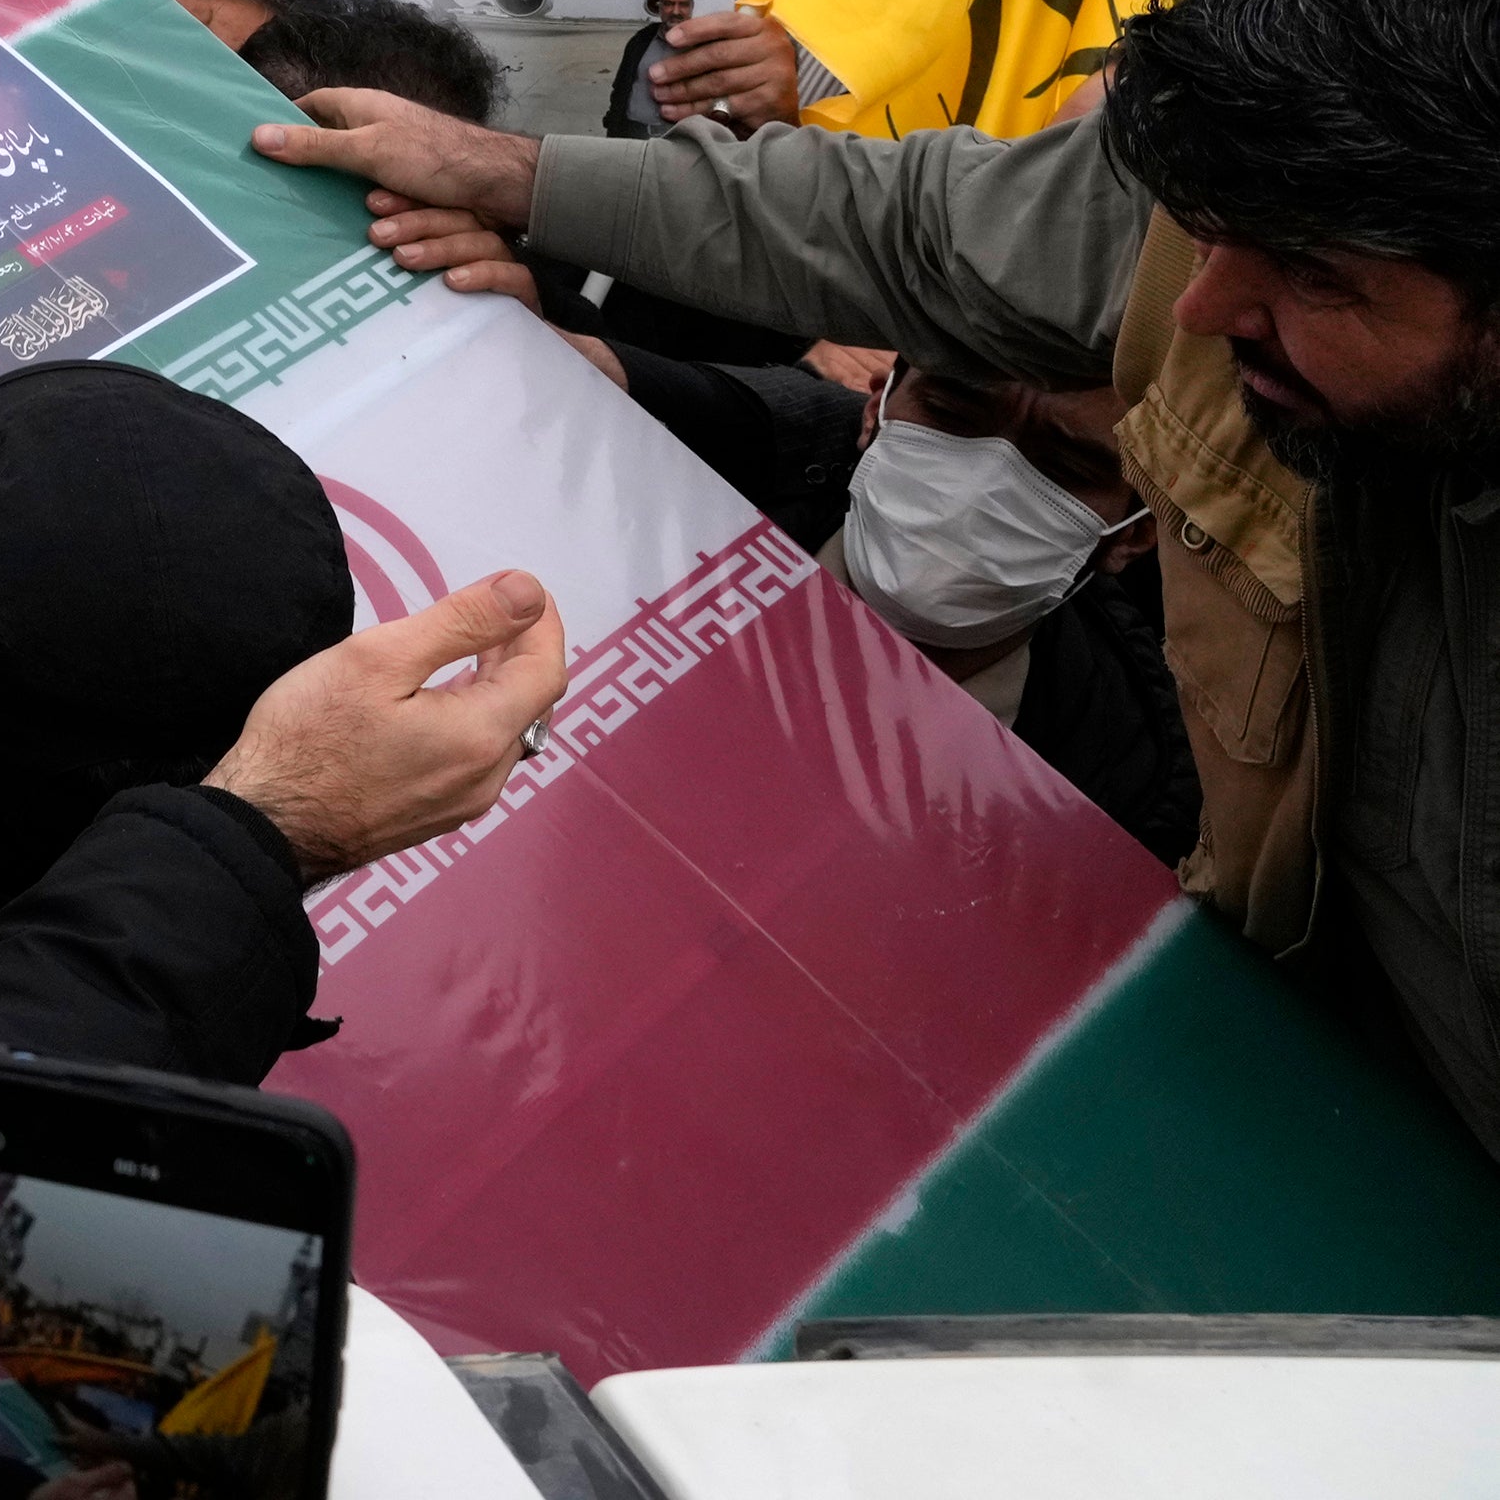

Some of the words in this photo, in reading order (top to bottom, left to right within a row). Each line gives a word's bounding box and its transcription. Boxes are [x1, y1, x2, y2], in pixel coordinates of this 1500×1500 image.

[28, 122, 64, 157] با
[40, 181, 68, 207] شهید
[10, 202, 41, 230] مدافع
[83, 199, 116, 227] شهادت
